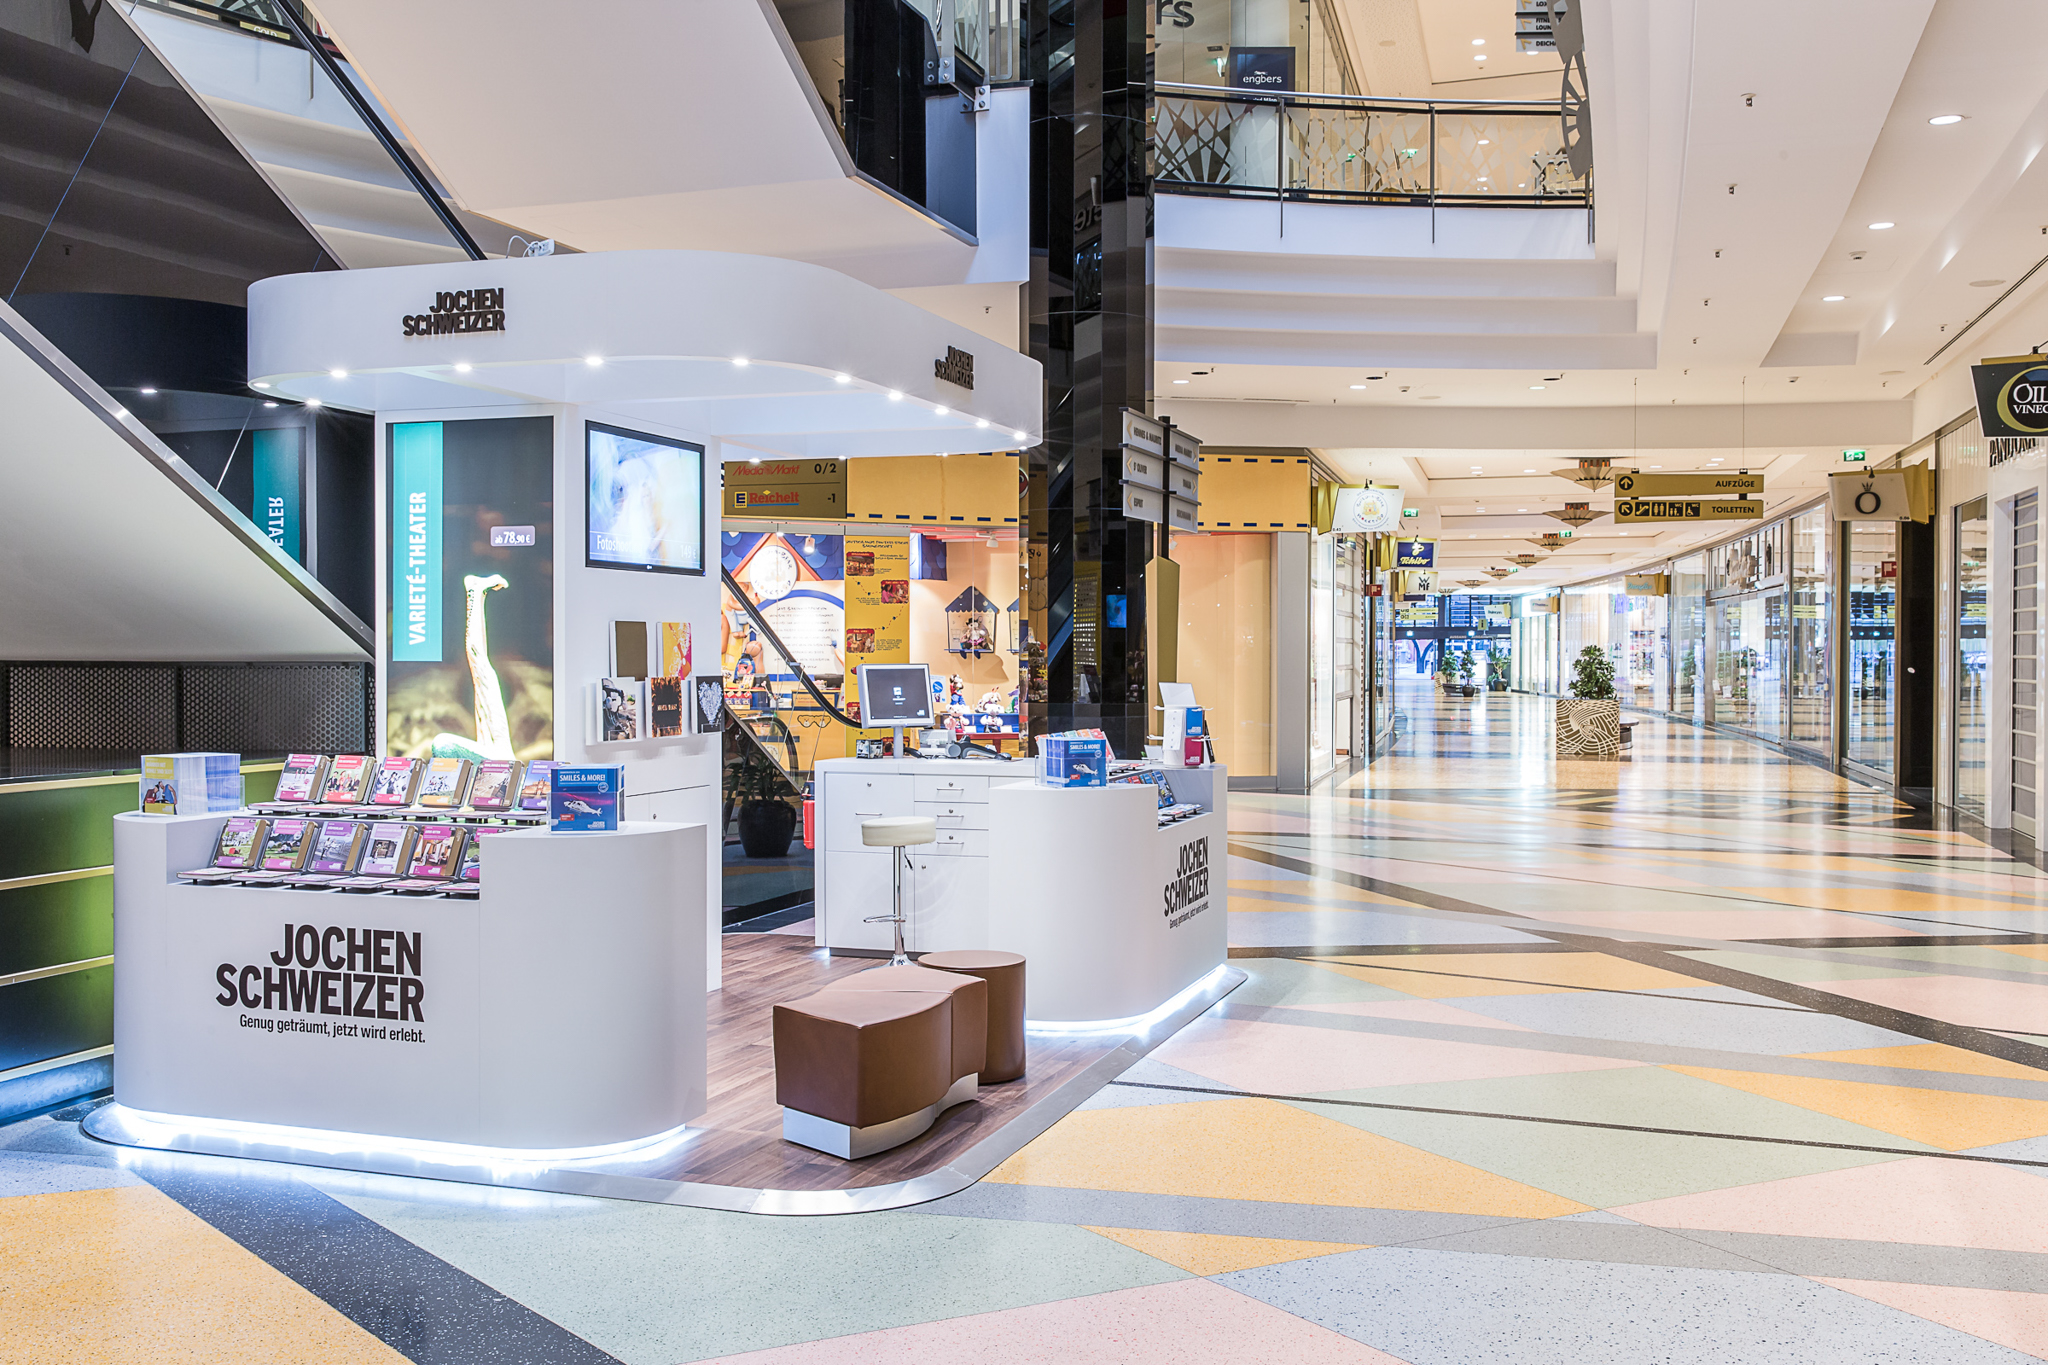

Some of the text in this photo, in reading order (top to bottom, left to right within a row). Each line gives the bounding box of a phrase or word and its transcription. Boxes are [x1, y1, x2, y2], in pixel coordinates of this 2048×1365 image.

[1243, 74, 1282, 85] engbers
[429, 288, 504, 313] JOCHEN
[403, 310, 506, 336] SCHWEIZER
[945, 345, 974, 372] JOCHEN
[935, 359, 975, 390] SCHWEIZER
[733, 463, 837, 476] Media Markt 0/2
[1715, 479, 1755, 488] AUFZÜGE
[749, 491, 800, 503] Reichelt
[828, 493, 836, 503] -1
[1712, 506, 1755, 514] TOILETTEN
[495, 531, 531, 544] ab 78,90 €
[406, 492, 426, 645] VARIETÉ-THEATER
[1400, 556, 1430, 565] Tchibo
[560, 774, 580, 782] SMILES
[1177, 836, 1208, 878] JOCHEN
[1164, 867, 1208, 917] SCHWEIZER
[270, 923, 421, 976] JOCHEN
[216, 963, 425, 1022] SCHWEIZER
[239, 1014, 426, 1043] Genug geträumt, jetzt wird erlebt.
